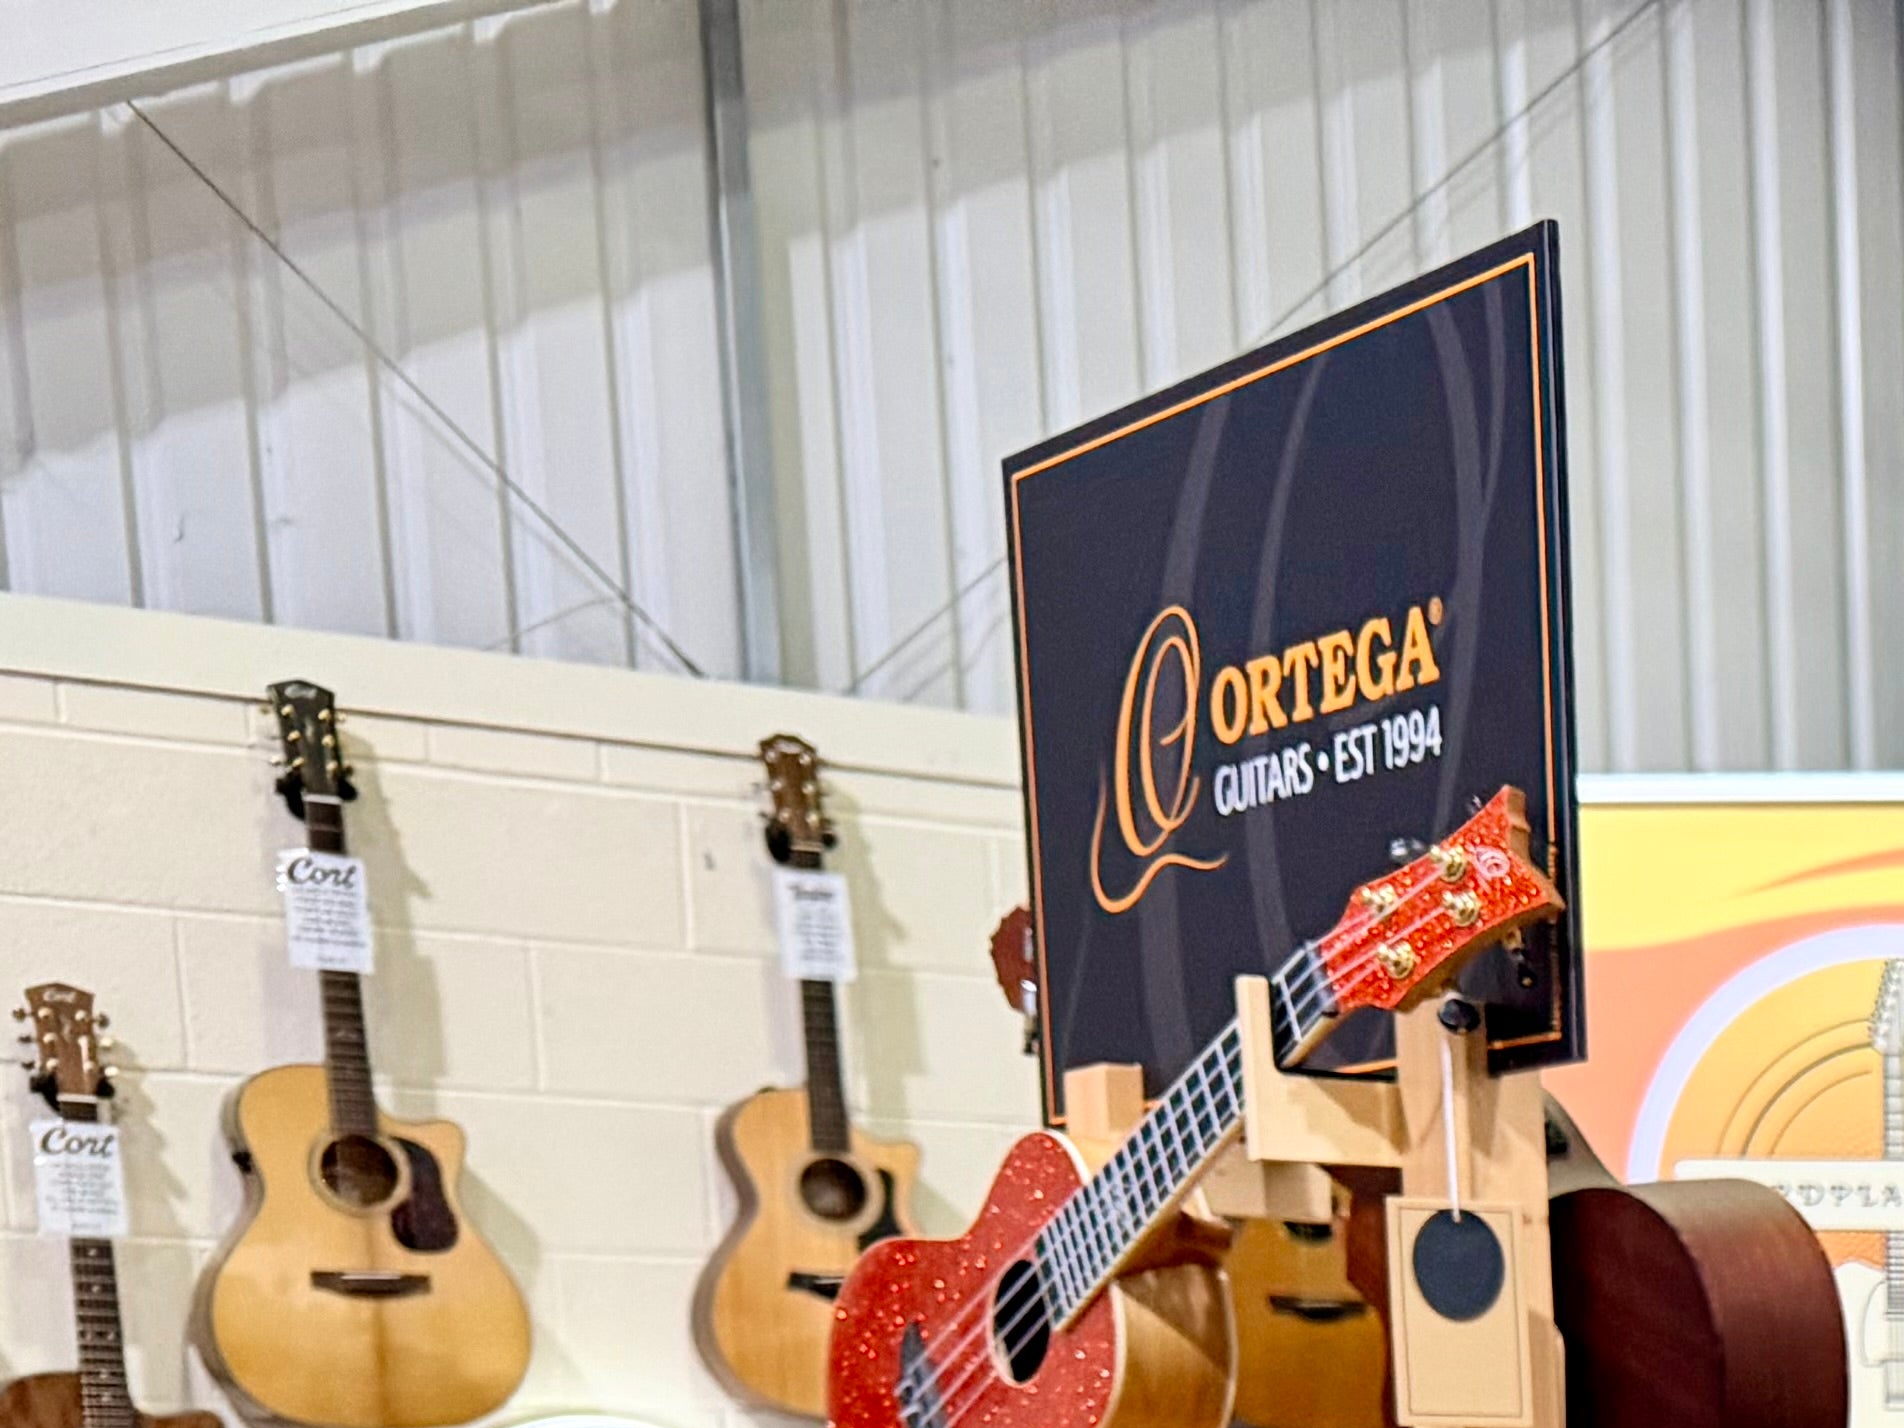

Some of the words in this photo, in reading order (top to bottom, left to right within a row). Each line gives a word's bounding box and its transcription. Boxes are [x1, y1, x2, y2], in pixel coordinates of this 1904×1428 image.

[1209, 606, 1441, 744] ORTEGA
[1214, 741, 1313, 816] GUITARS
[1333, 723, 1379, 783] EST
[1382, 705, 1443, 770] 1994
[287, 856, 358, 888] Cort
[40, 1127, 115, 1158] Cort
